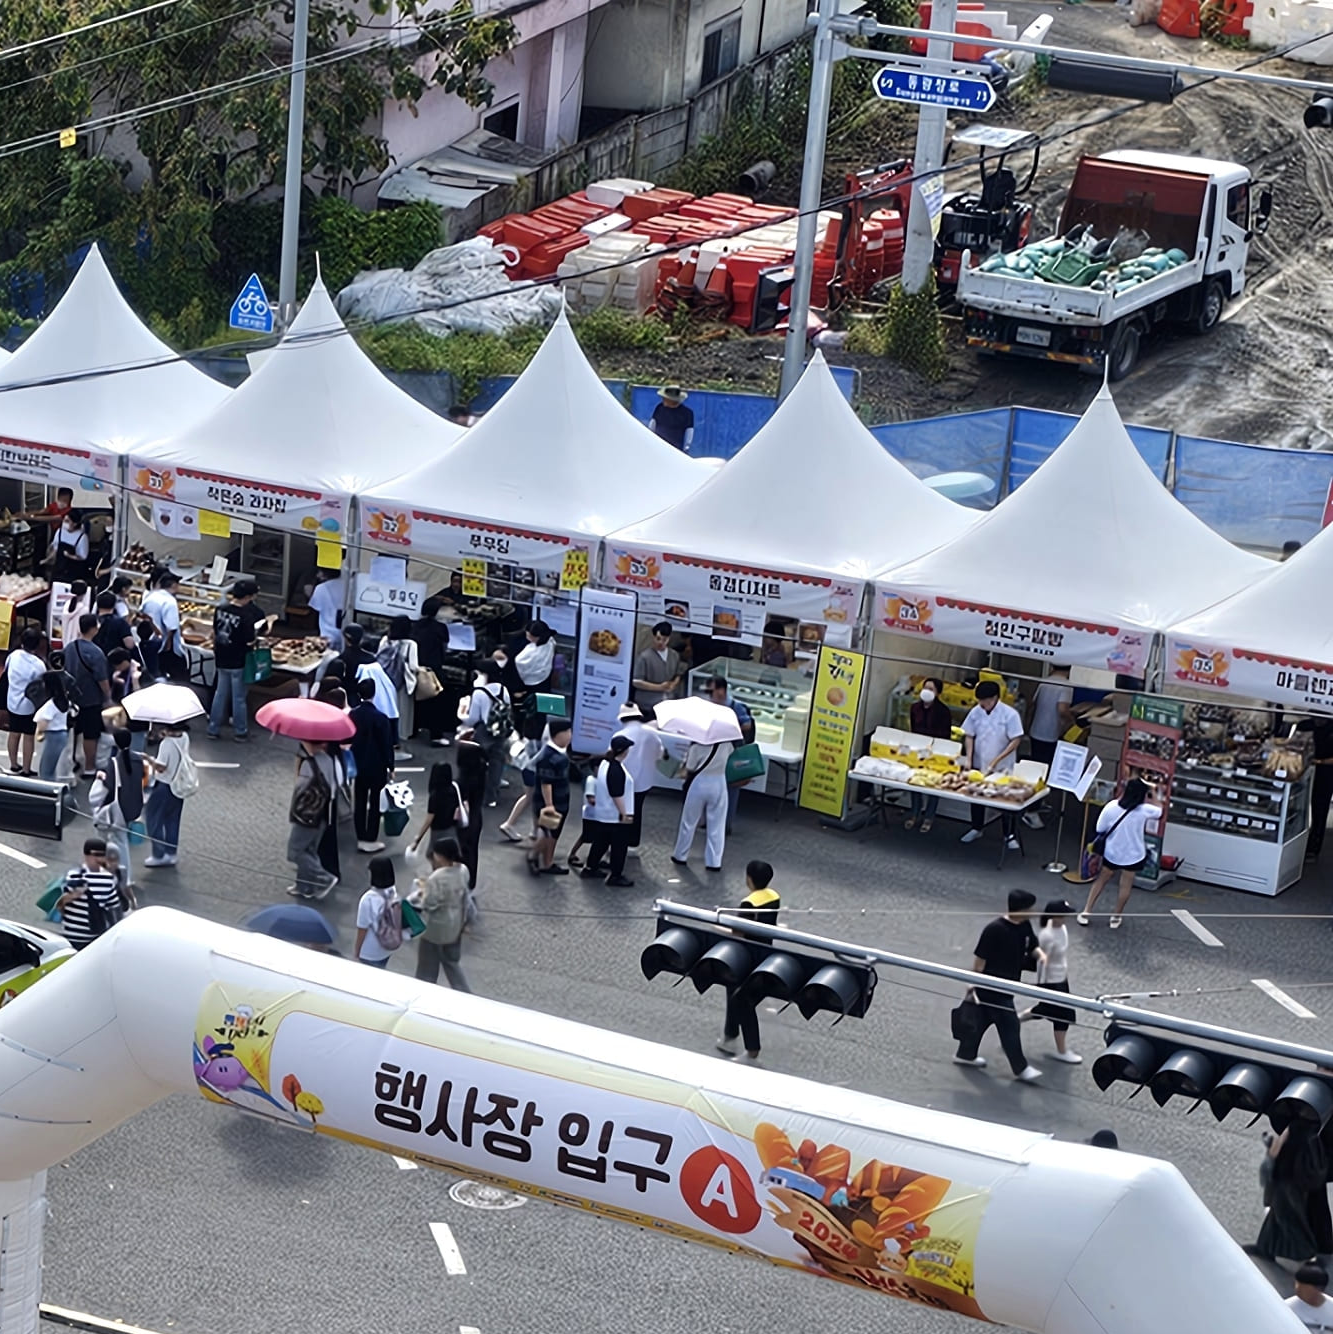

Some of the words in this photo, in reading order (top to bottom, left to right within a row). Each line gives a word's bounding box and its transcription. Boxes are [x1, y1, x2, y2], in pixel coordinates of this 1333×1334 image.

[373, 1061, 544, 1163] 행사장
[557, 1112, 674, 1193] 입구
[701, 1163, 739, 1218] A
